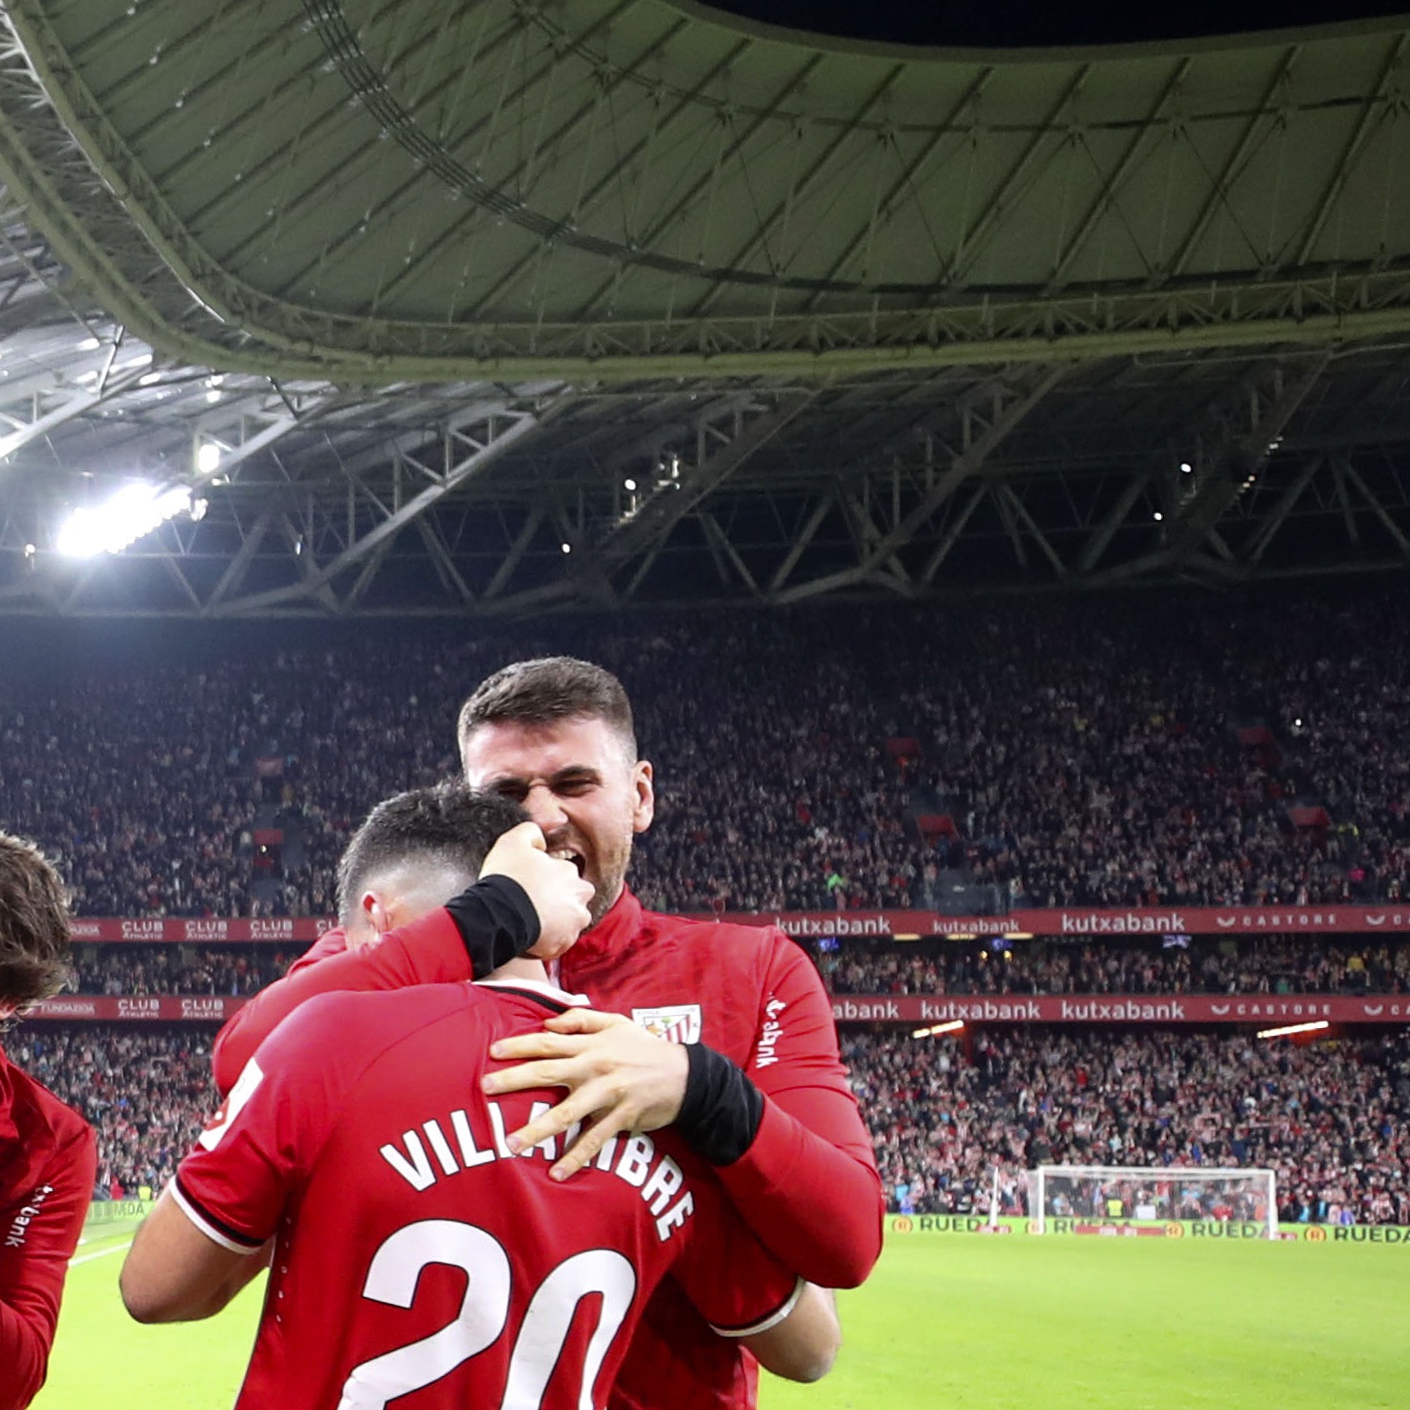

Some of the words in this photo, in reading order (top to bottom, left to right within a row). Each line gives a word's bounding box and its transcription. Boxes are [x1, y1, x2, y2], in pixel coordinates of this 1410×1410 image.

[121, 921, 164, 932] CLUB
[185, 920, 228, 932] CLUB
[250, 919, 293, 932] CLUB
[775, 916, 892, 936] kutxabank
[933, 918, 1020, 933] kutxabank
[1062, 913, 1186, 933] kutxabank
[117, 999, 160, 1010] CLUB
[181, 999, 224, 1010] CLUB
[832, 1000, 900, 1020] abank
[921, 1000, 1041, 1020] kutxabank
[1061, 999, 1185, 1020] kutxabank
